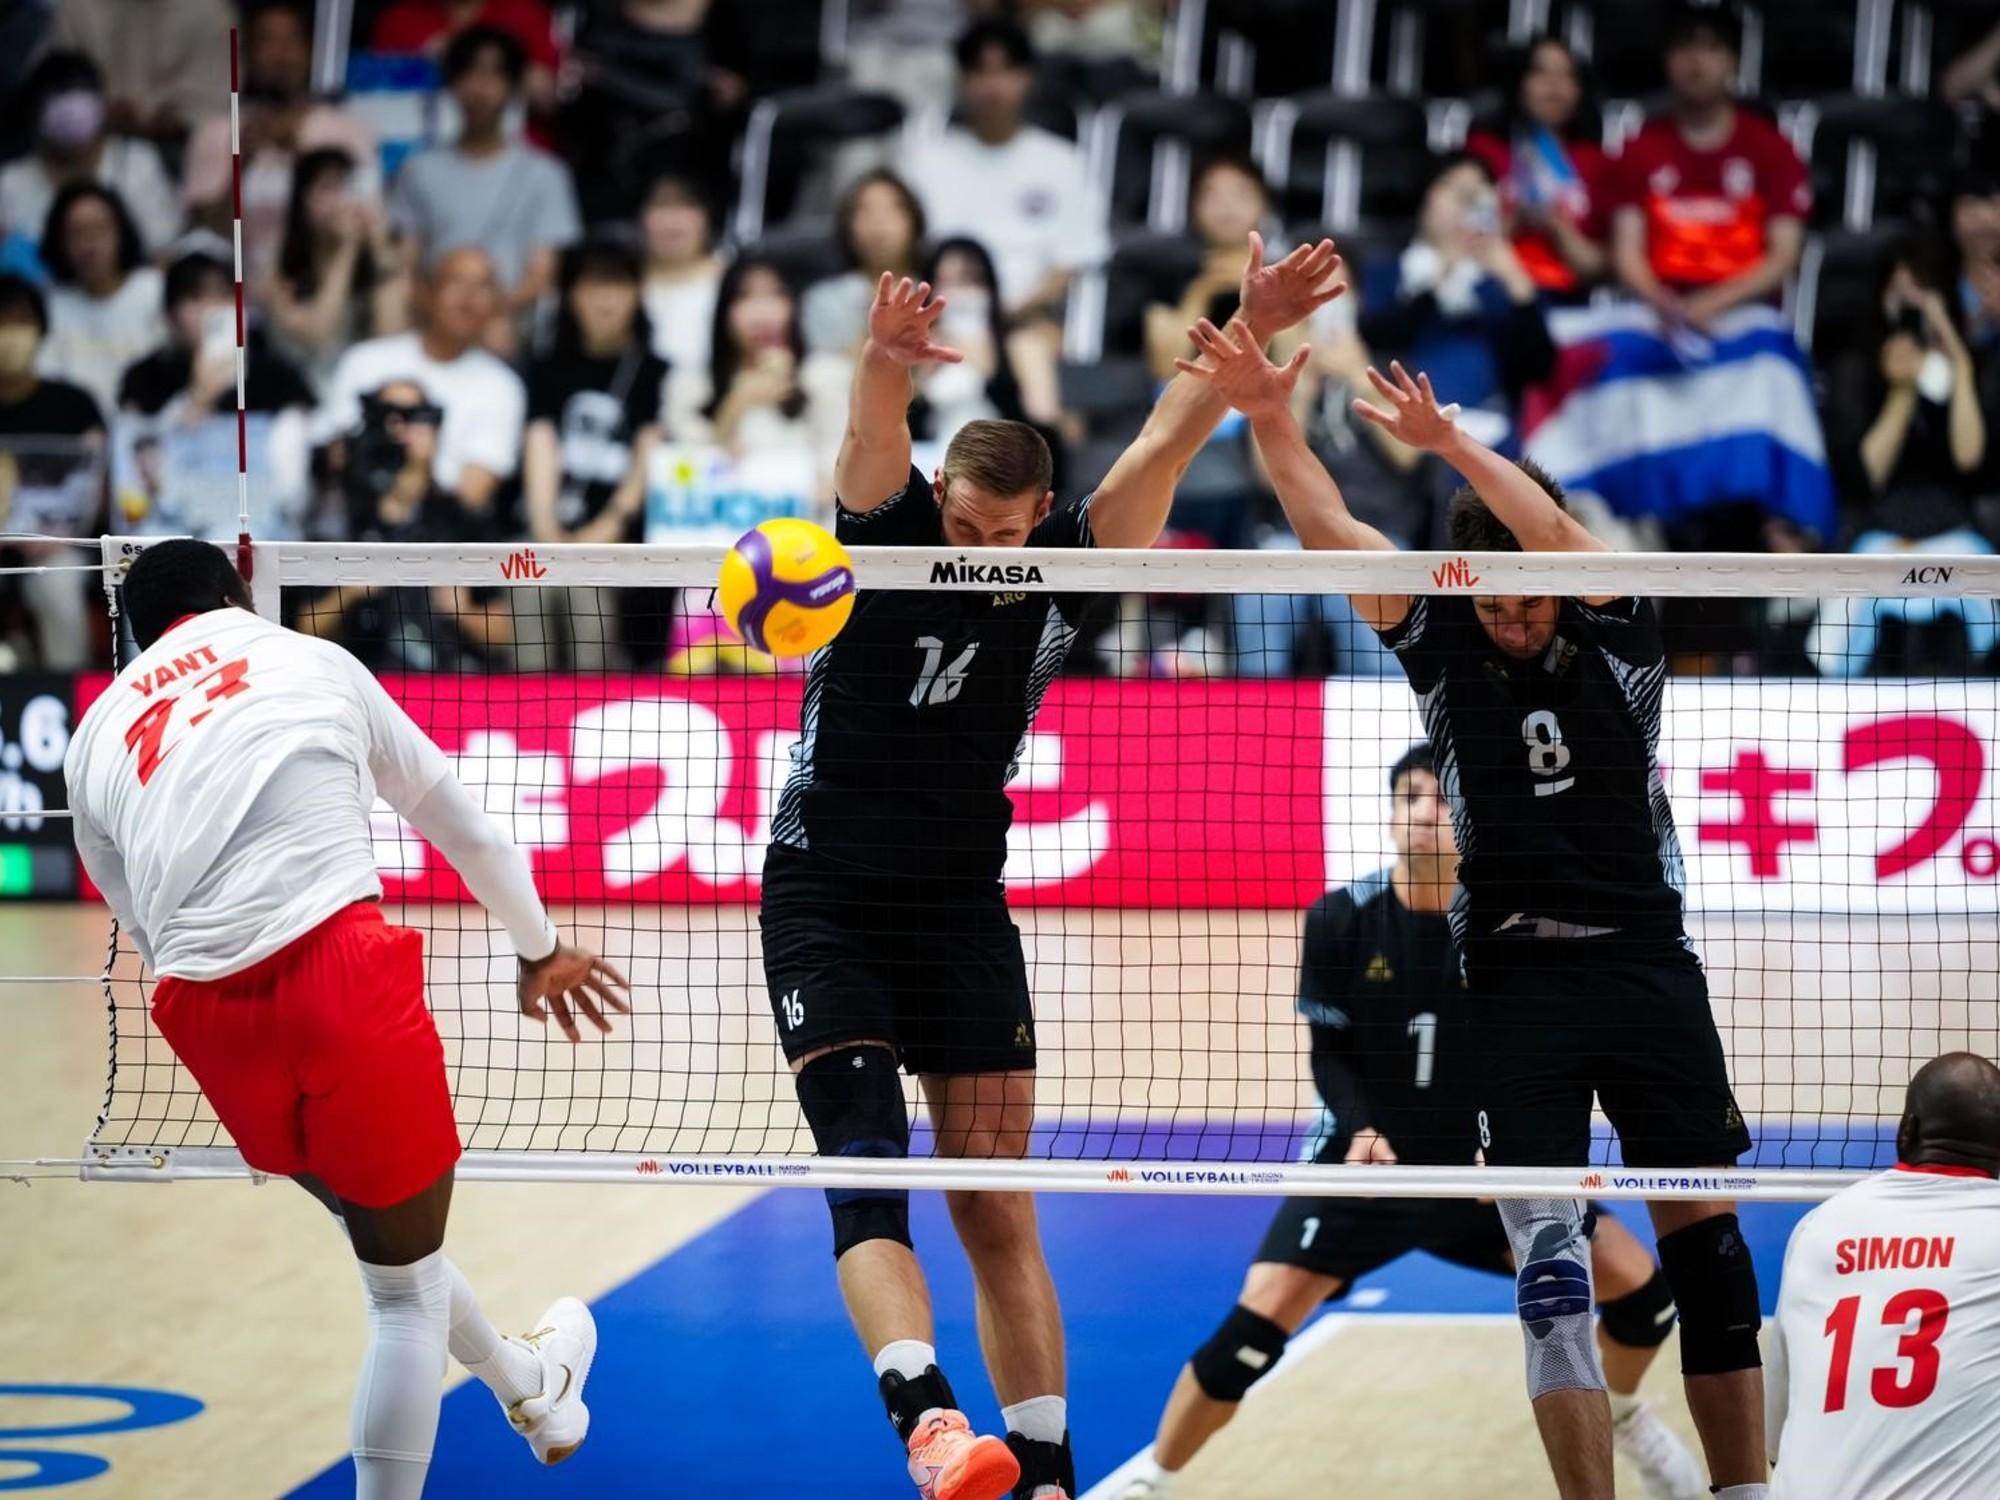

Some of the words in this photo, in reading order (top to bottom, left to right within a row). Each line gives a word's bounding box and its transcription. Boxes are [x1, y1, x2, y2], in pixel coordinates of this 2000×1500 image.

[500, 548, 547, 579] VNL
[929, 554, 1044, 584] MIKASA
[1432, 557, 1479, 588] VNL
[1901, 566, 1954, 584] ACN
[130, 645, 218, 697] YANT
[1522, 710, 1575, 797] 8
[782, 989, 804, 1031] 16
[1408, 1012, 1437, 1087] 1
[1478, 1110, 1491, 1148] 8
[669, 1163, 775, 1176] VOLLEYBALL
[1141, 1171, 1249, 1184] VOLLEYBALL
[1613, 1178, 1721, 1190] VOLLEYBALL
[1301, 1217, 1320, 1249] 1
[1836, 1237, 1954, 1275] SIMON
[1824, 1288, 1949, 1414] 13
